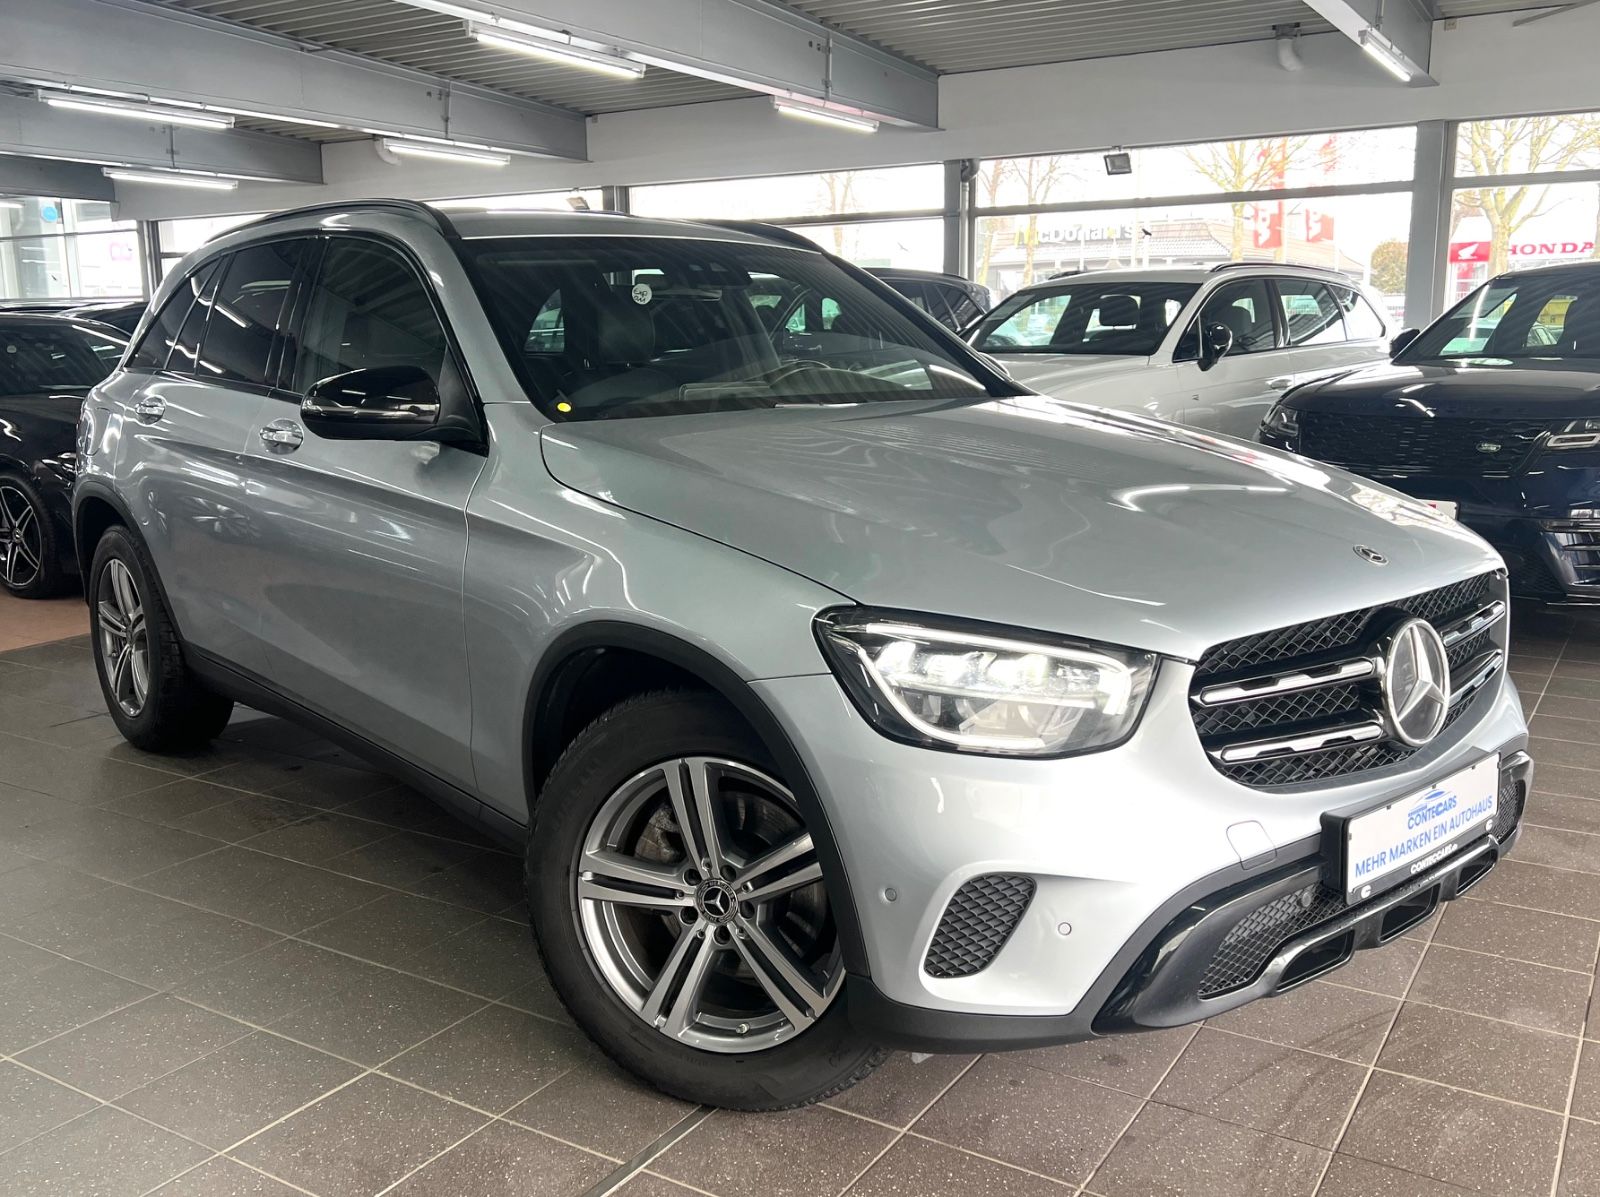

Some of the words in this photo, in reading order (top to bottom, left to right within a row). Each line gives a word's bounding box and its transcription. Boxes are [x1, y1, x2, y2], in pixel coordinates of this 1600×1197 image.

[1355, 851, 1387, 878] MEHR
[1389, 830, 1431, 863] MARKEN
[1433, 821, 1448, 841] EIN
[1449, 795, 1493, 831] AUTOHAUS
